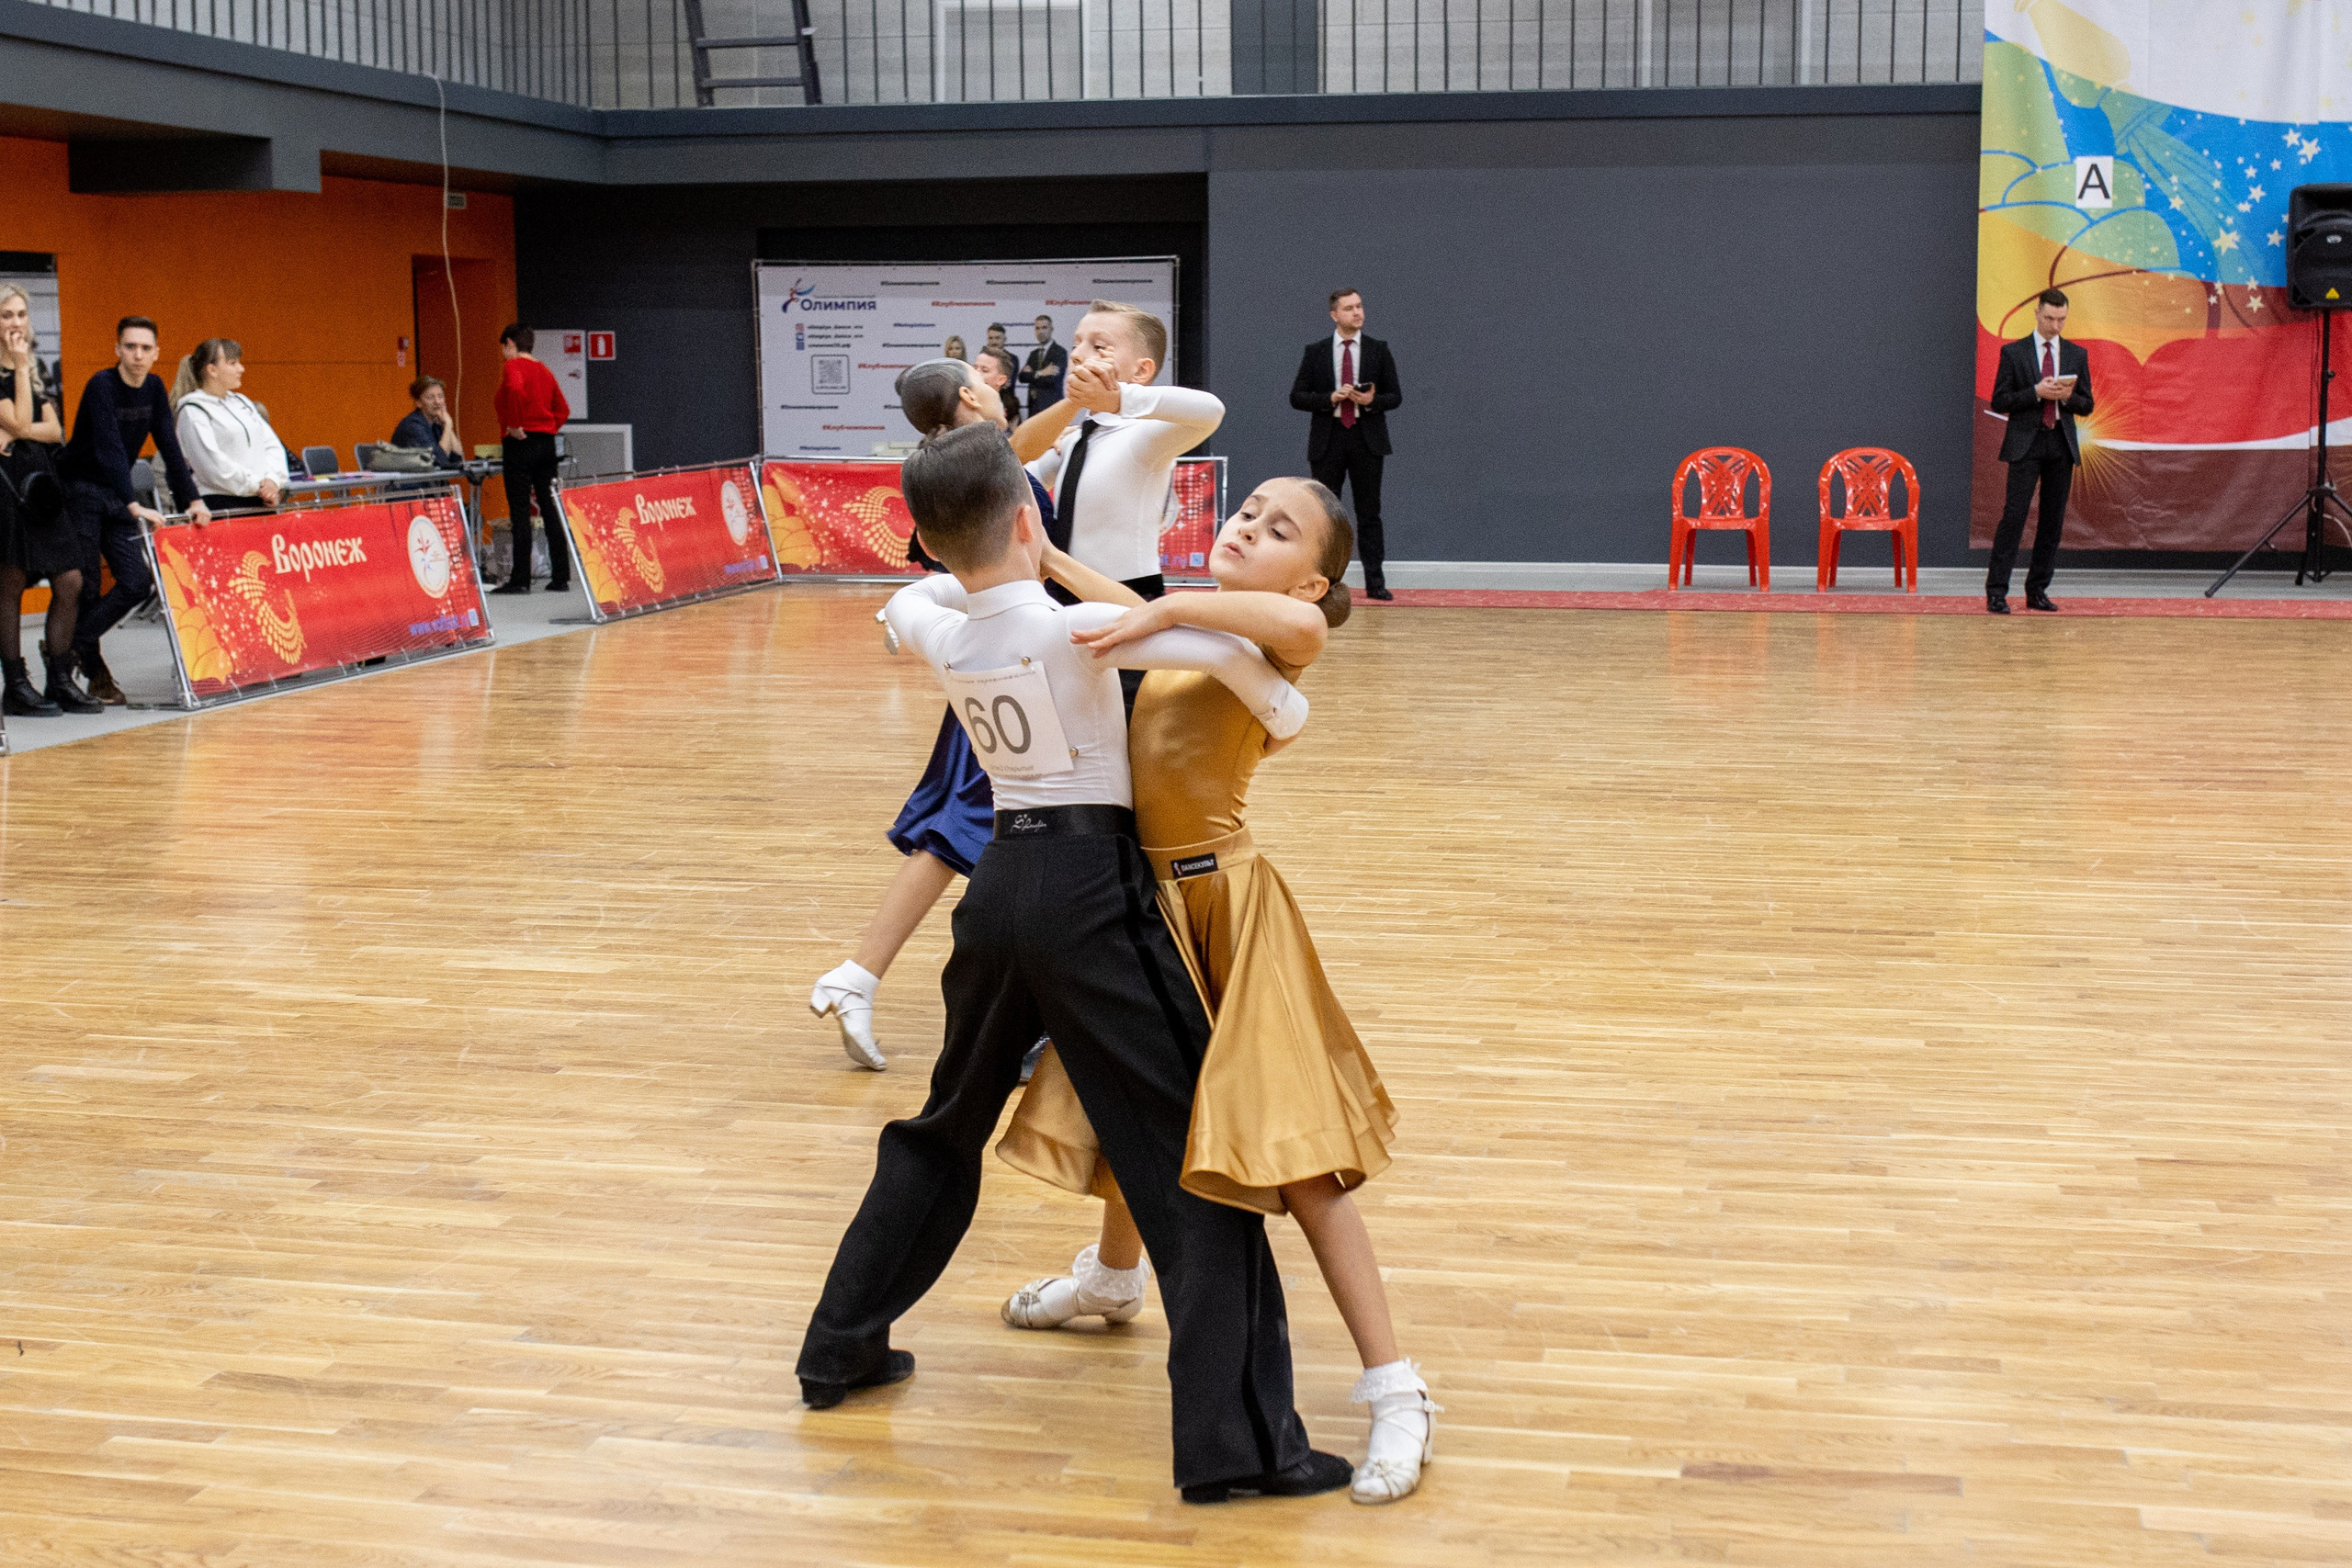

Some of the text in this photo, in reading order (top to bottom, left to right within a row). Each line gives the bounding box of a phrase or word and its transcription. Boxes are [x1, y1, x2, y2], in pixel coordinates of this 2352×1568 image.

[2077, 164, 2110, 199] A
[800, 299, 876, 311] Олимпия
[272, 534, 367, 582] Воронеж
[965, 694, 1032, 754] 60
